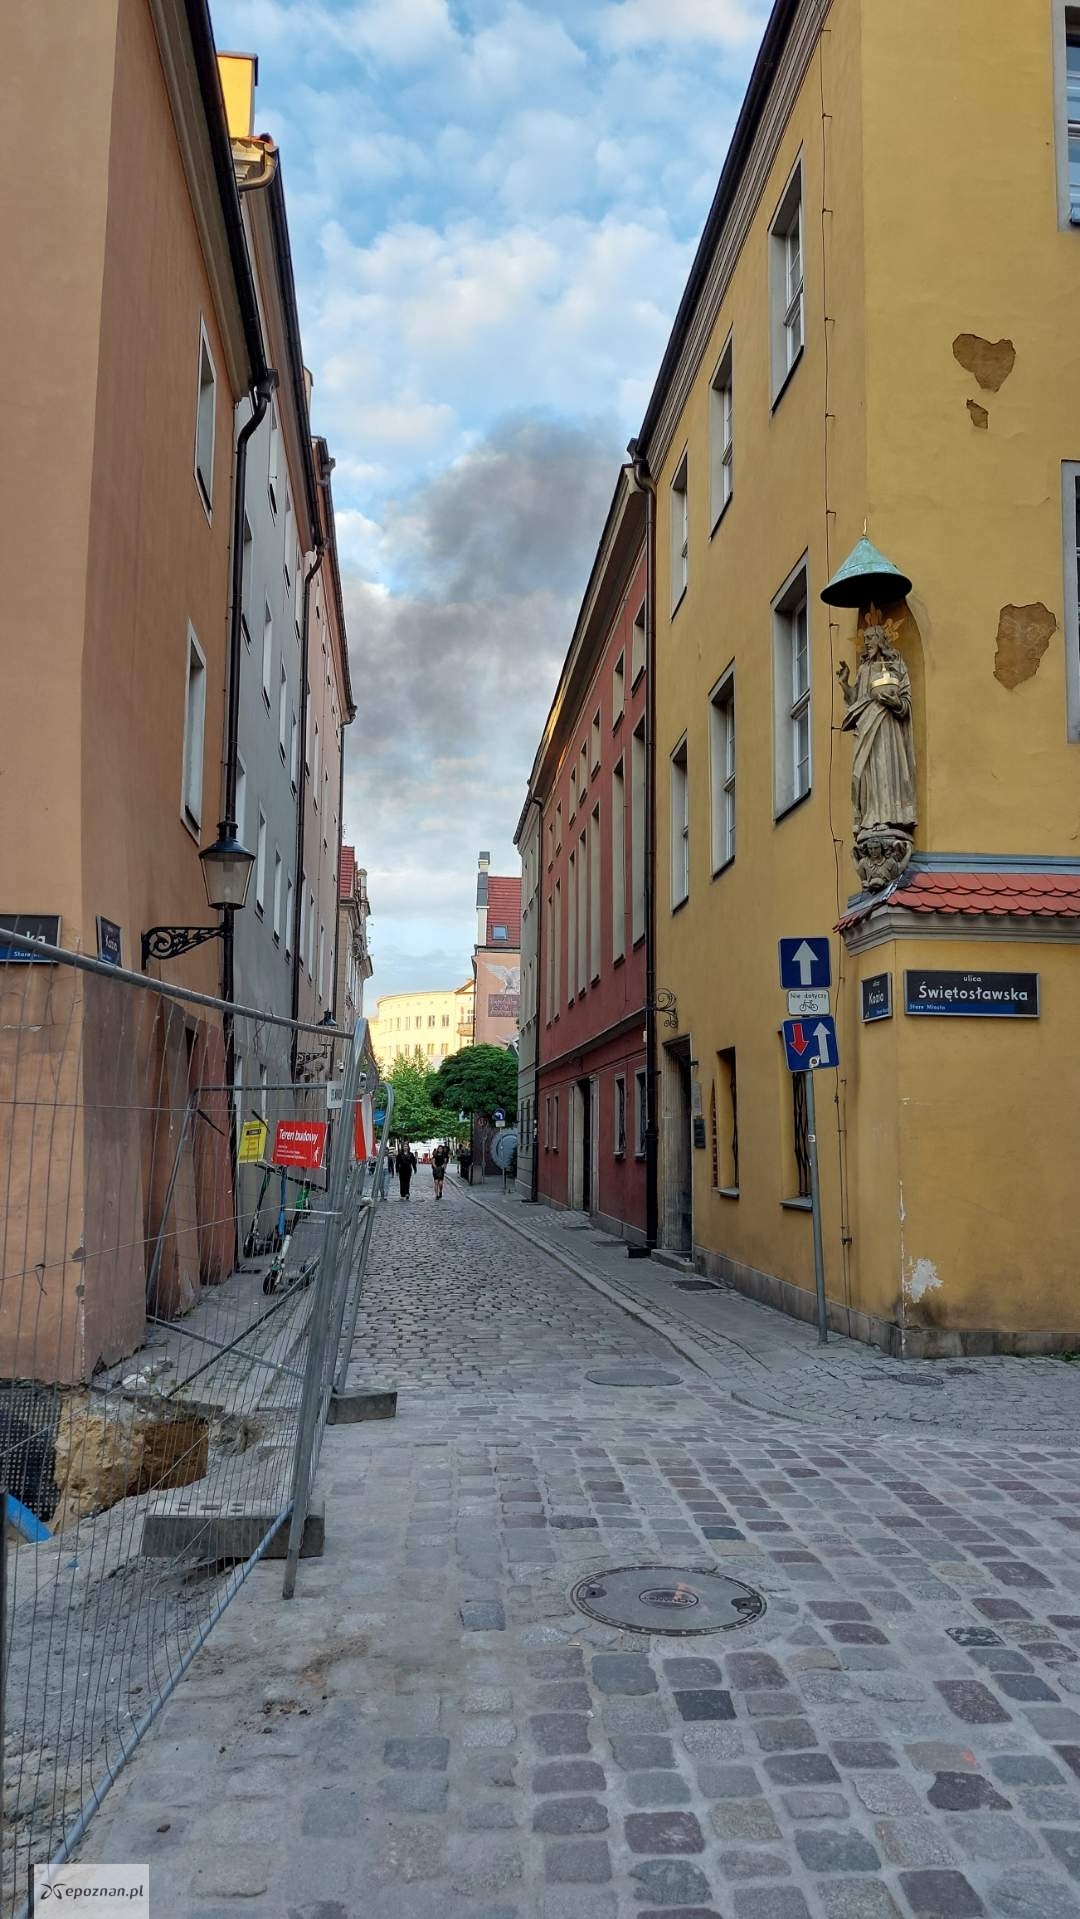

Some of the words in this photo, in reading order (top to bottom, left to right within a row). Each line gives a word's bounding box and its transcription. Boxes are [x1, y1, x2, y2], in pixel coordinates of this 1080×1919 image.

[918, 981, 1028, 1002] Świętosławska
[279, 1128, 294, 1141] Teren
[295, 1130, 318, 1145] budowy
